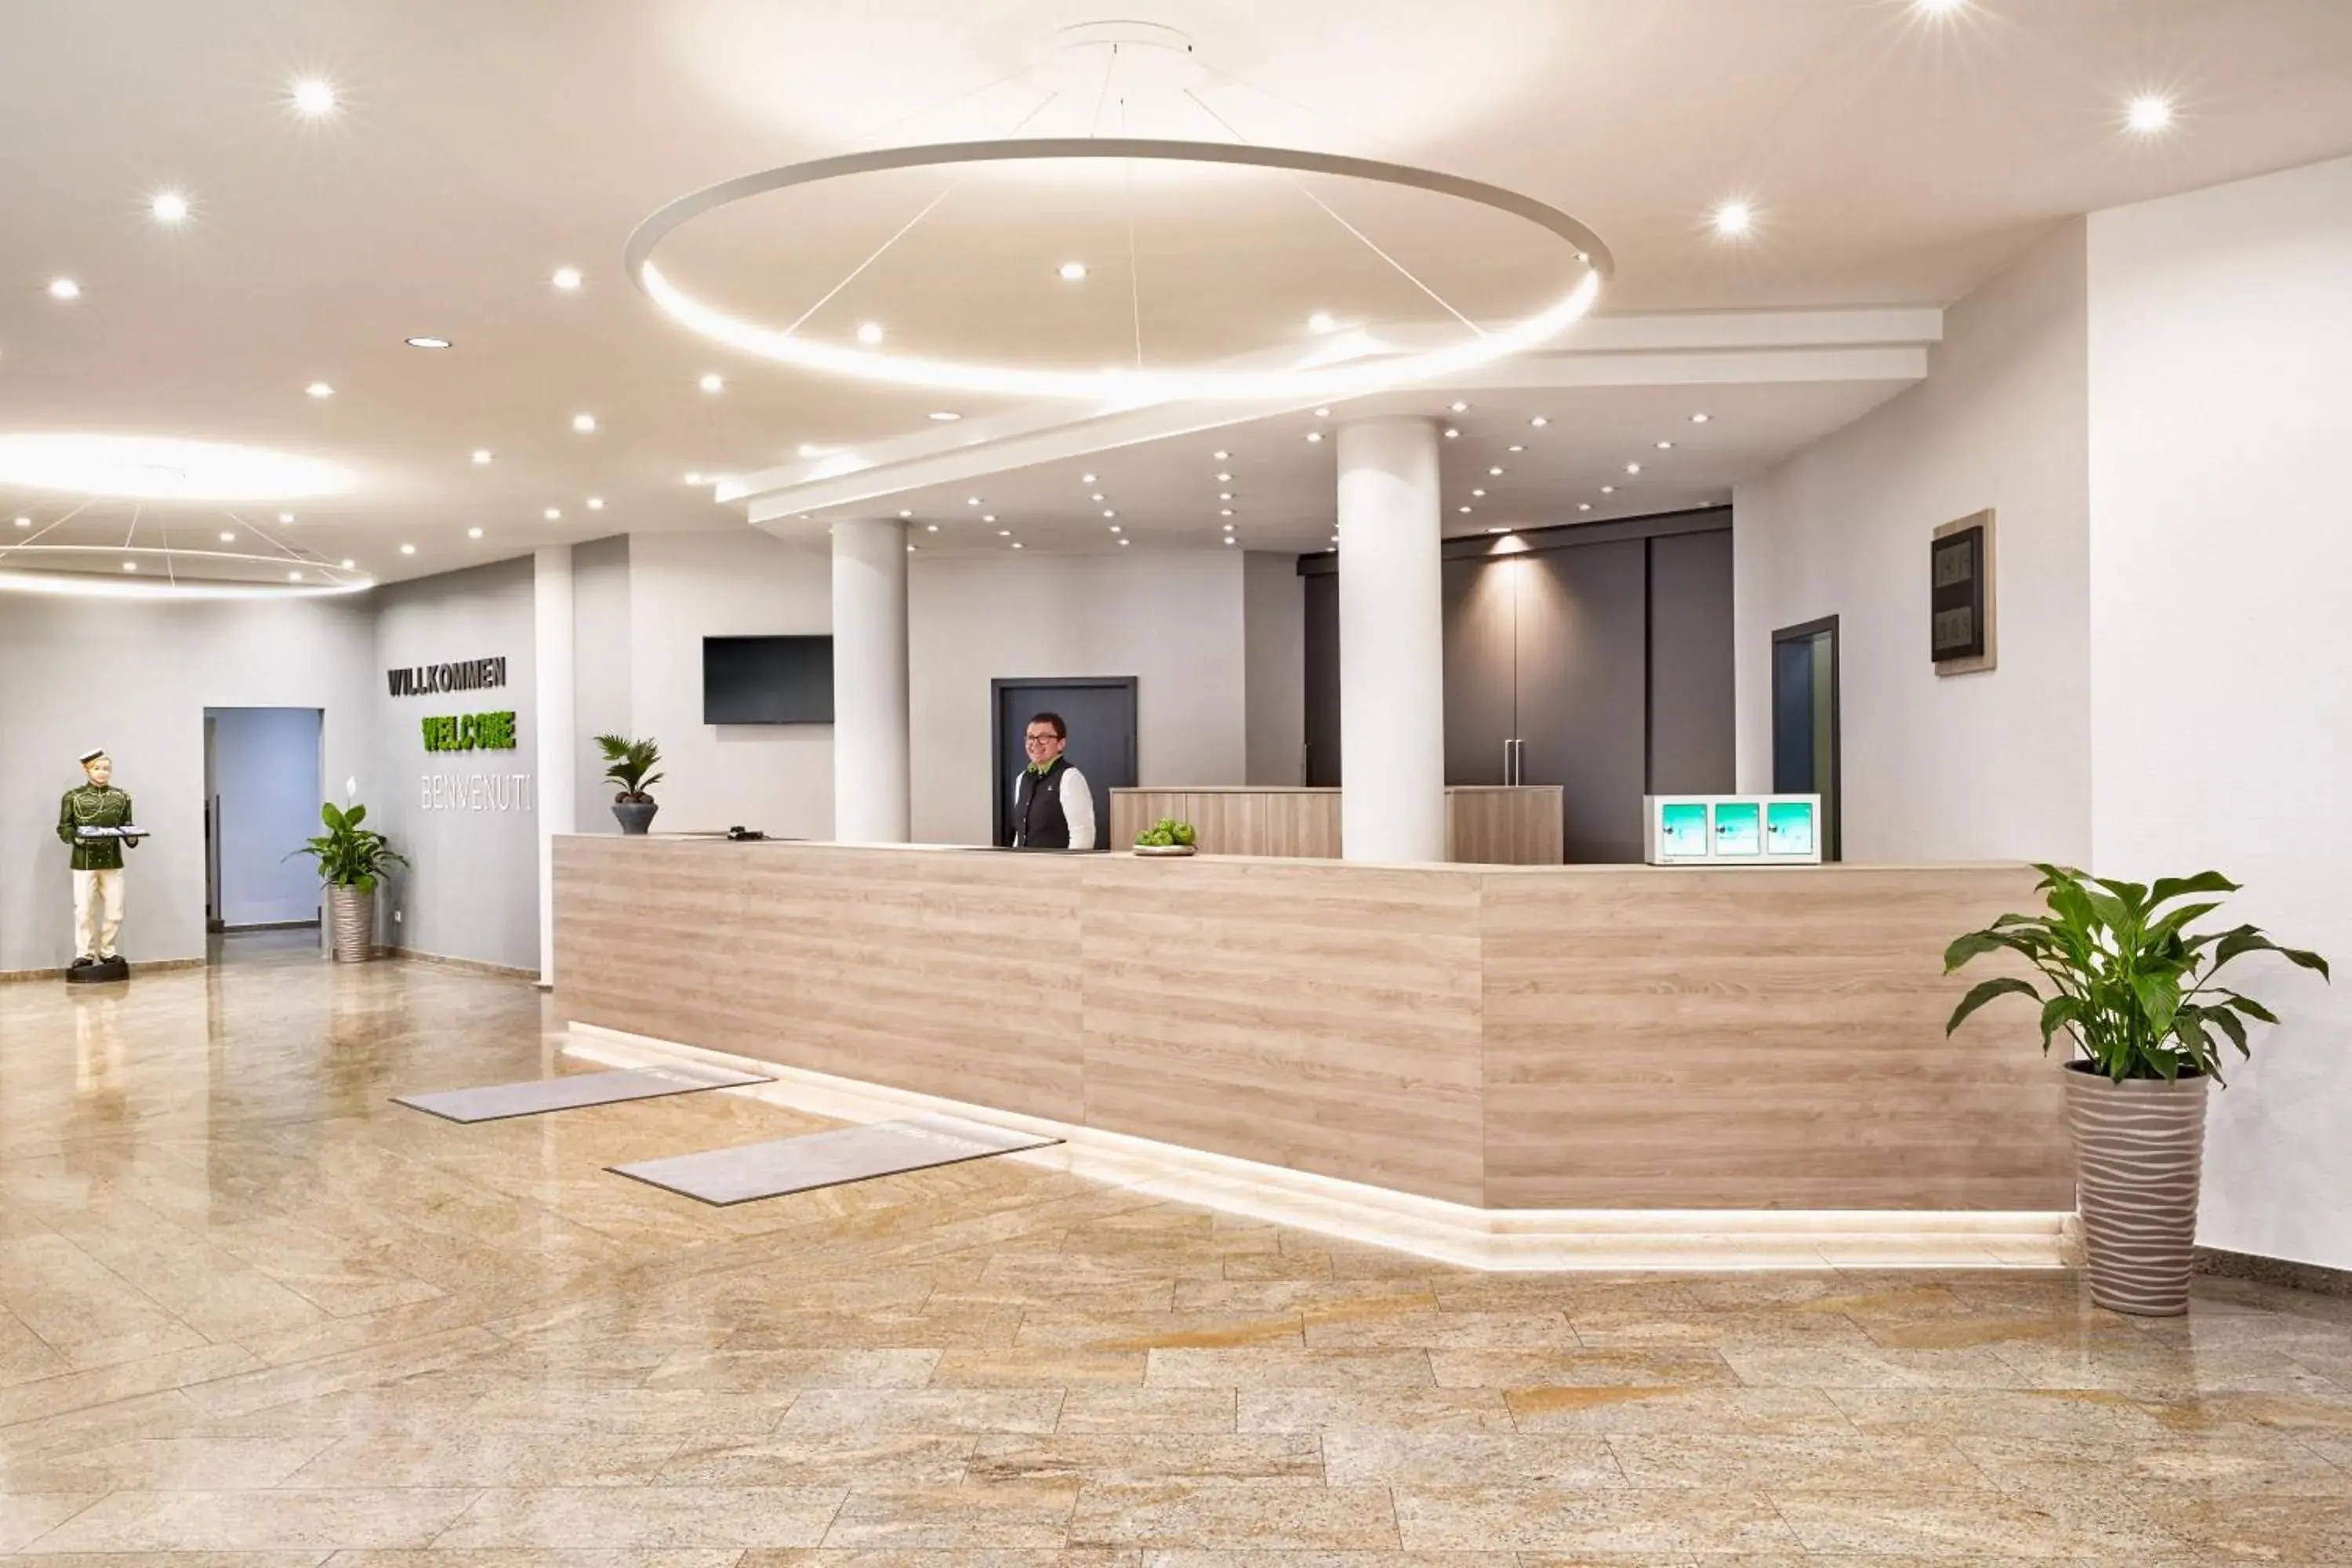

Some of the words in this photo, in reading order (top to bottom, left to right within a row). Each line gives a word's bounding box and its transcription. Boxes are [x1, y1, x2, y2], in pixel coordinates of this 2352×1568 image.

[387, 656, 506, 697] WILLKOMMEN
[422, 711, 516, 751] WELCOME
[421, 774, 532, 810] BENVENUTI
